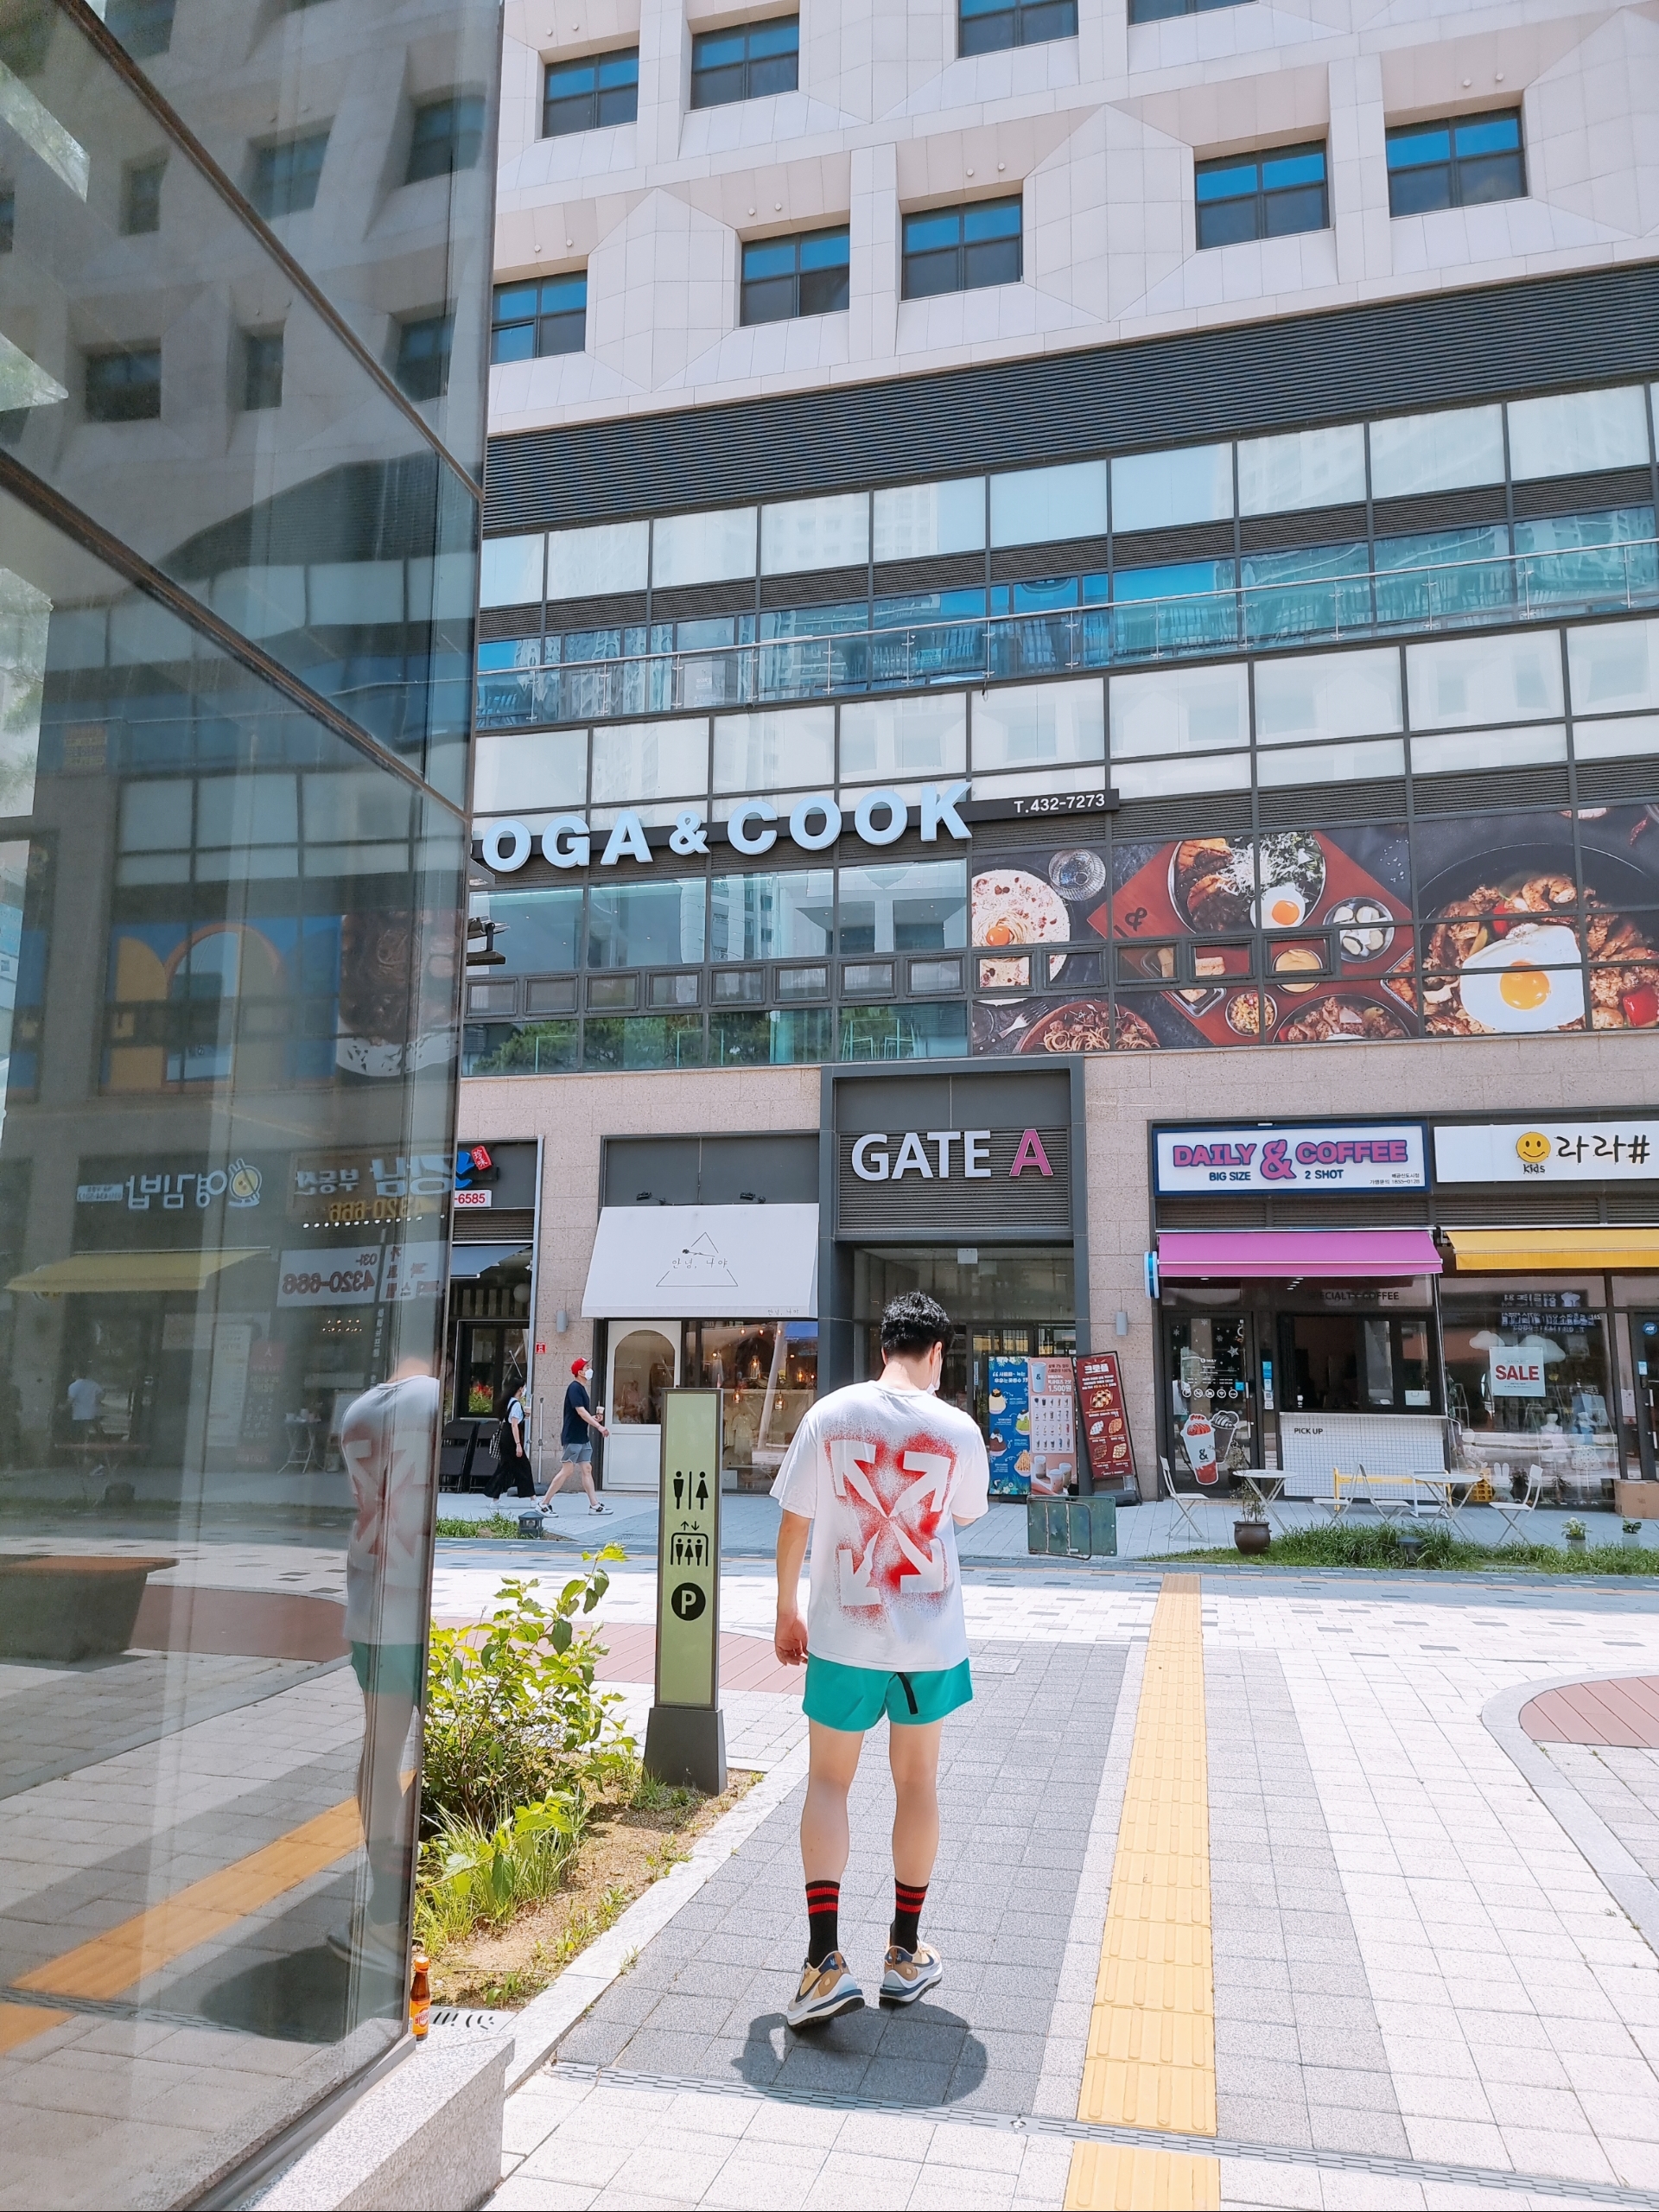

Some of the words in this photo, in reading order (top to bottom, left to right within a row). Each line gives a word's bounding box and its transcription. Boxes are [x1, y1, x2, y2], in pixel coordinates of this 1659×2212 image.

[1014, 792, 1105, 813] T.432-7273
[669, 810, 710, 855] &
[727, 781, 974, 855] COOK
[851, 1130, 992, 1181] GATE
[1008, 1128, 1054, 1177] A
[1173, 1143, 1257, 1167] DAILY
[1260, 1139, 1296, 1180] &
[1295, 1140, 1408, 1165] COFFEE
[1209, 1172, 1227, 1181] BIG
[1229, 1171, 1252, 1181] SIZE
[1304, 1170, 1311, 1180] 2
[1315, 1170, 1344, 1180] SHOT
[1523, 1163, 1546, 1174] kids
[706, 1257, 728, 1268] 나야
[1362, 1291, 1400, 1300] COFFEE
[1495, 1365, 1540, 1381] SALE
